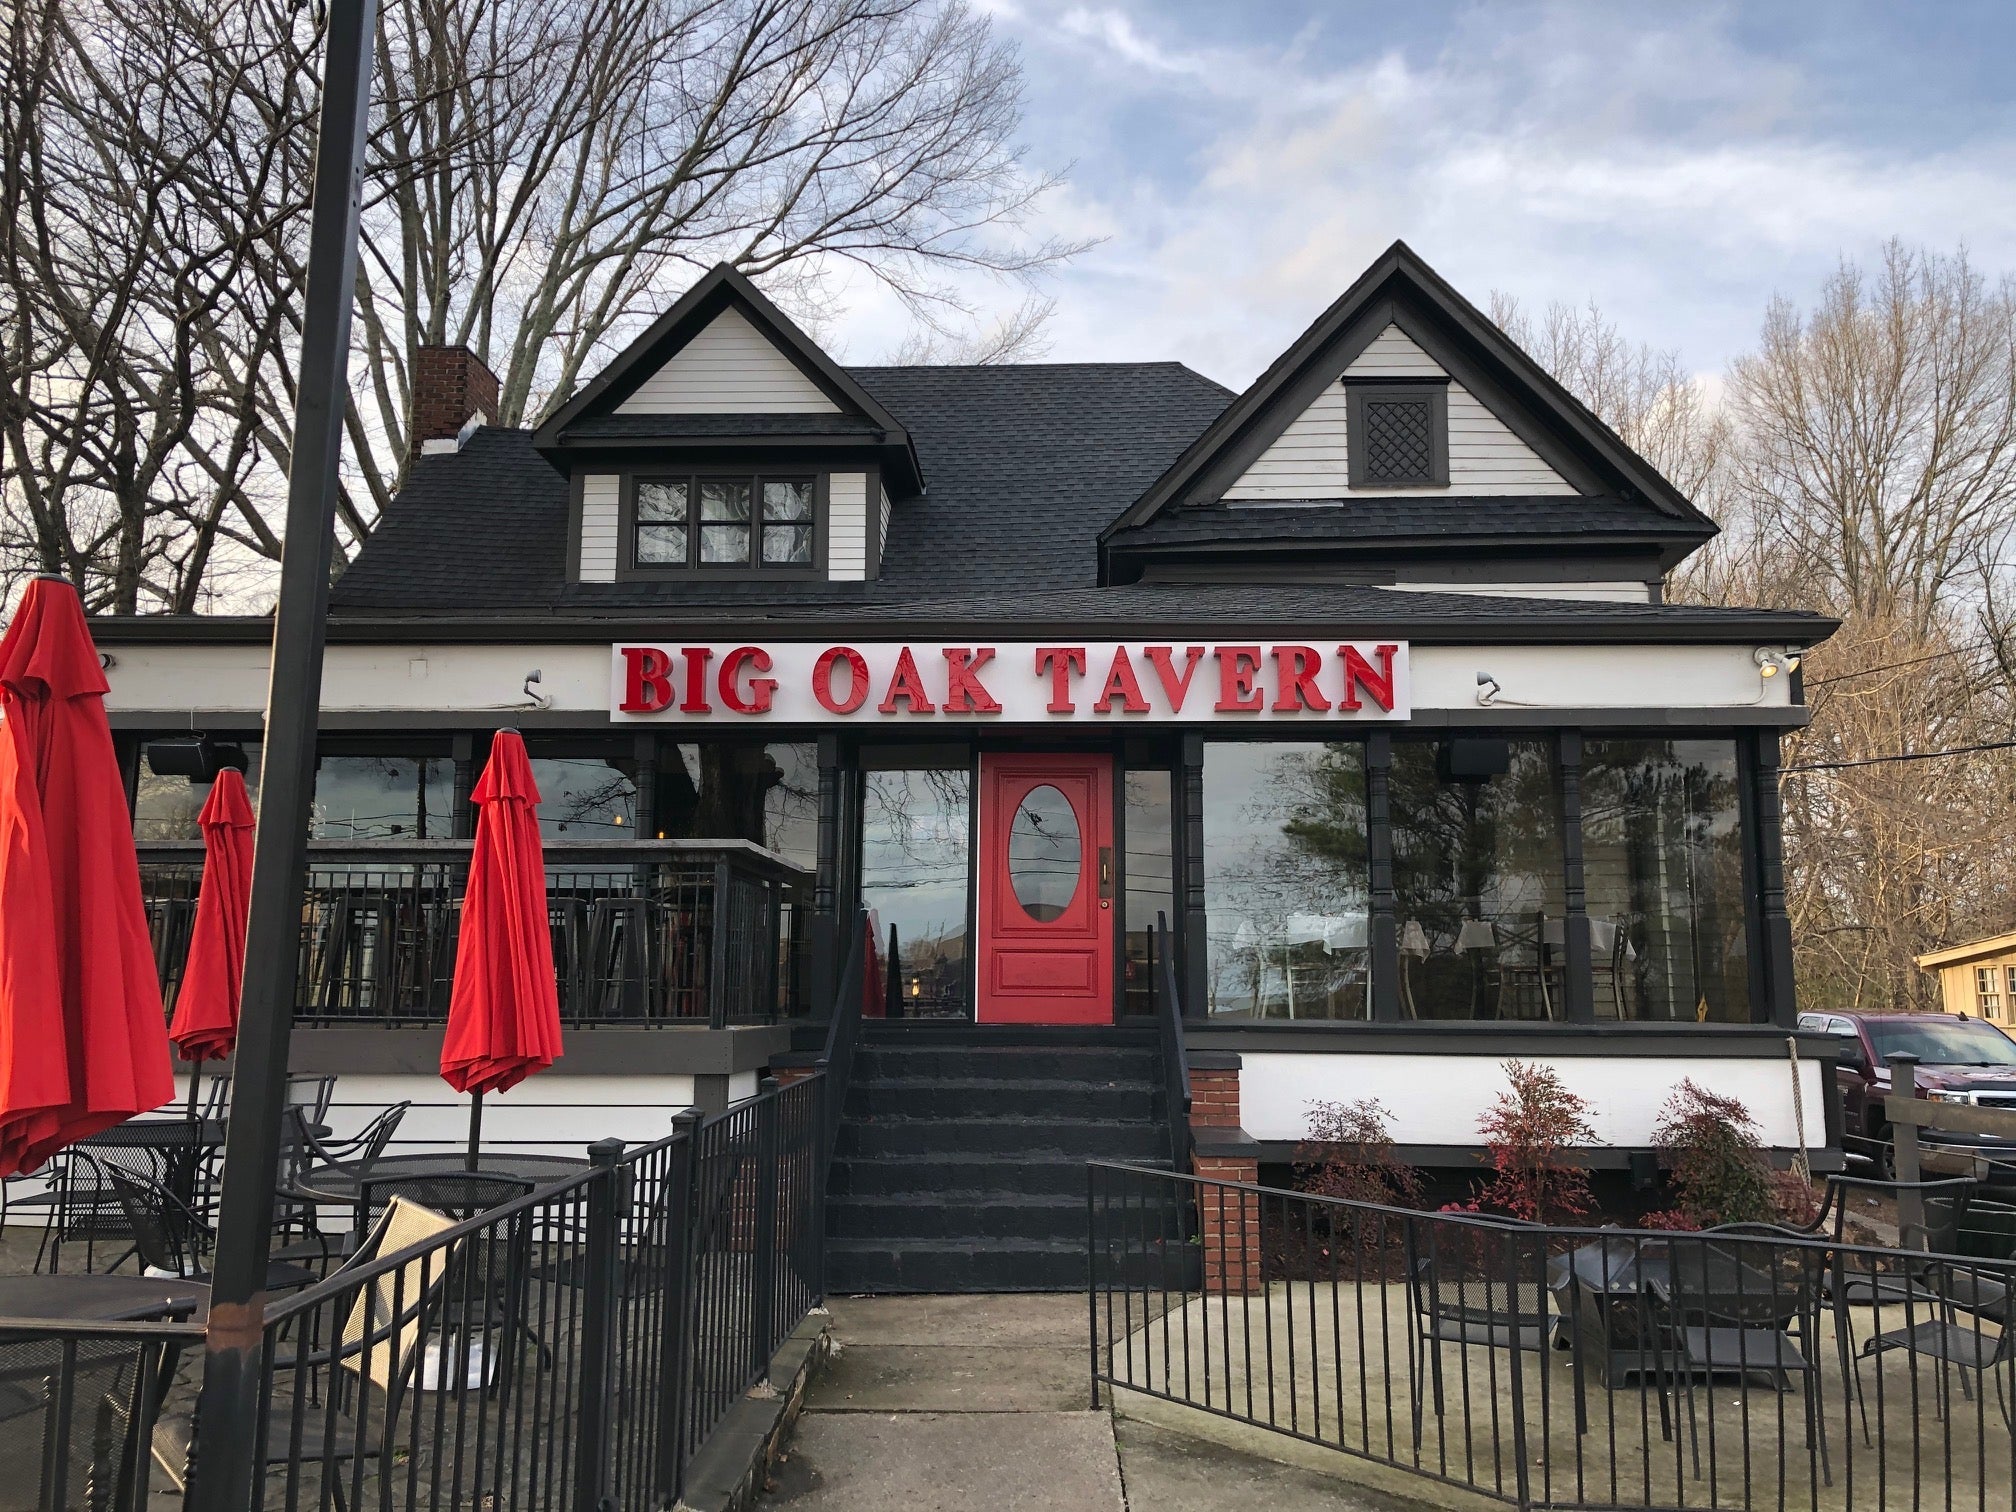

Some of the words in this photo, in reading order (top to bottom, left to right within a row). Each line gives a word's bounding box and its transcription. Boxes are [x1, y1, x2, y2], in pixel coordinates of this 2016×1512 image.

[619, 646, 779, 714] BIG
[811, 646, 1003, 714] OAK
[1034, 644, 1399, 713] TAVERN
